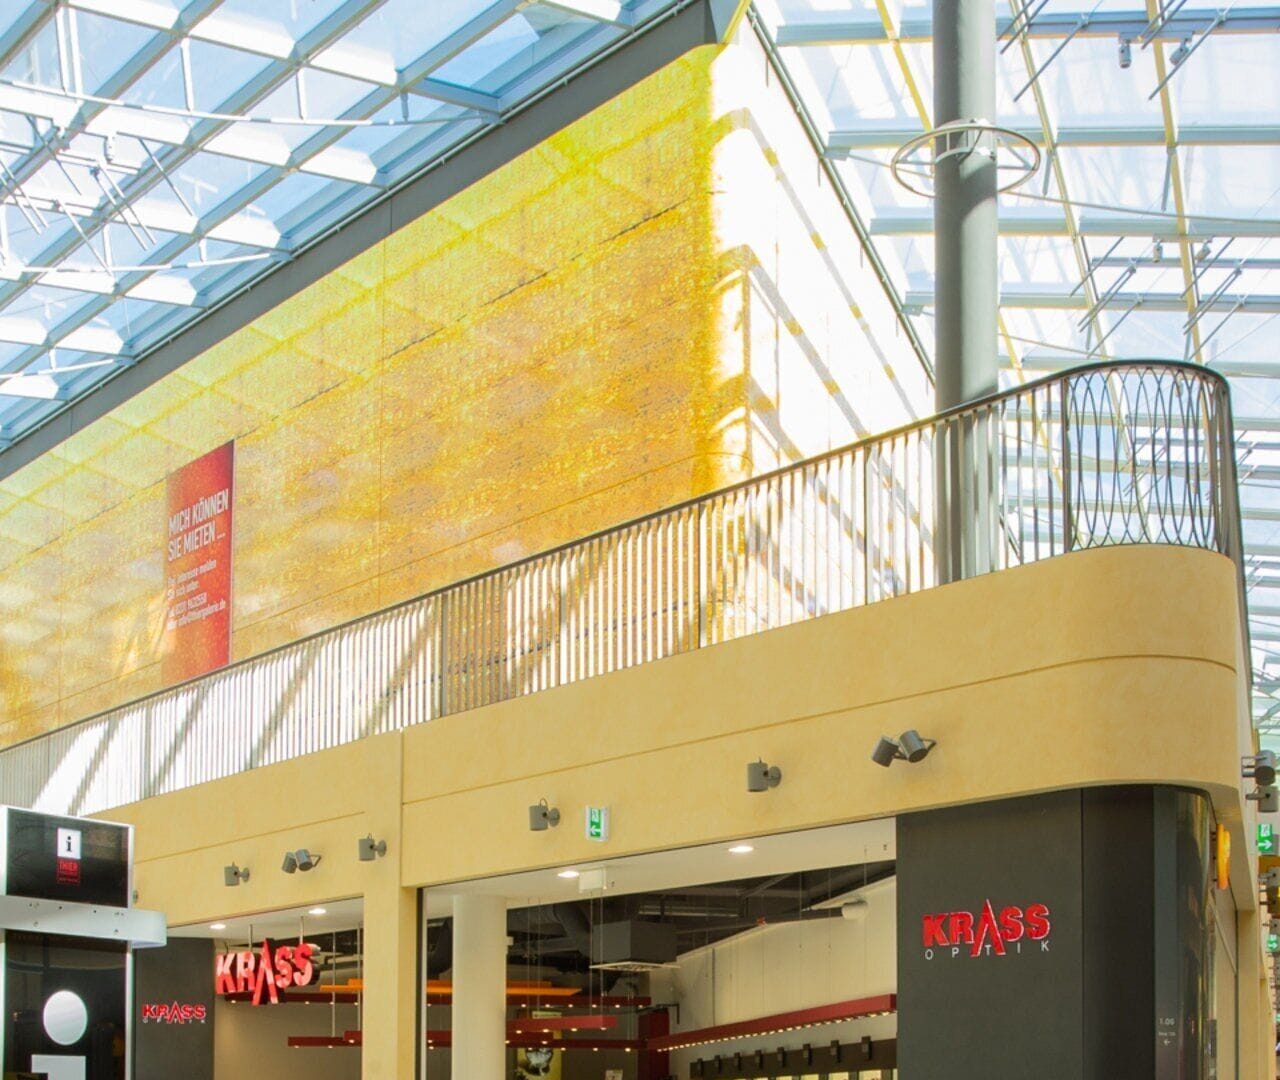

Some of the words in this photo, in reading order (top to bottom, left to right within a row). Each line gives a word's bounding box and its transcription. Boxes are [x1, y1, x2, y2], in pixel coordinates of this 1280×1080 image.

[169, 507, 190, 535] MICH
[192, 488, 229, 526] KÖNNEN
[168, 536, 181, 560] SIE
[184, 520, 216, 554] MIETEN
[922, 898, 1051, 957] KRASS
[924, 940, 1050, 961] OPTIK
[214, 938, 314, 1007] KRASS
[142, 1001, 207, 1024] KRASS
